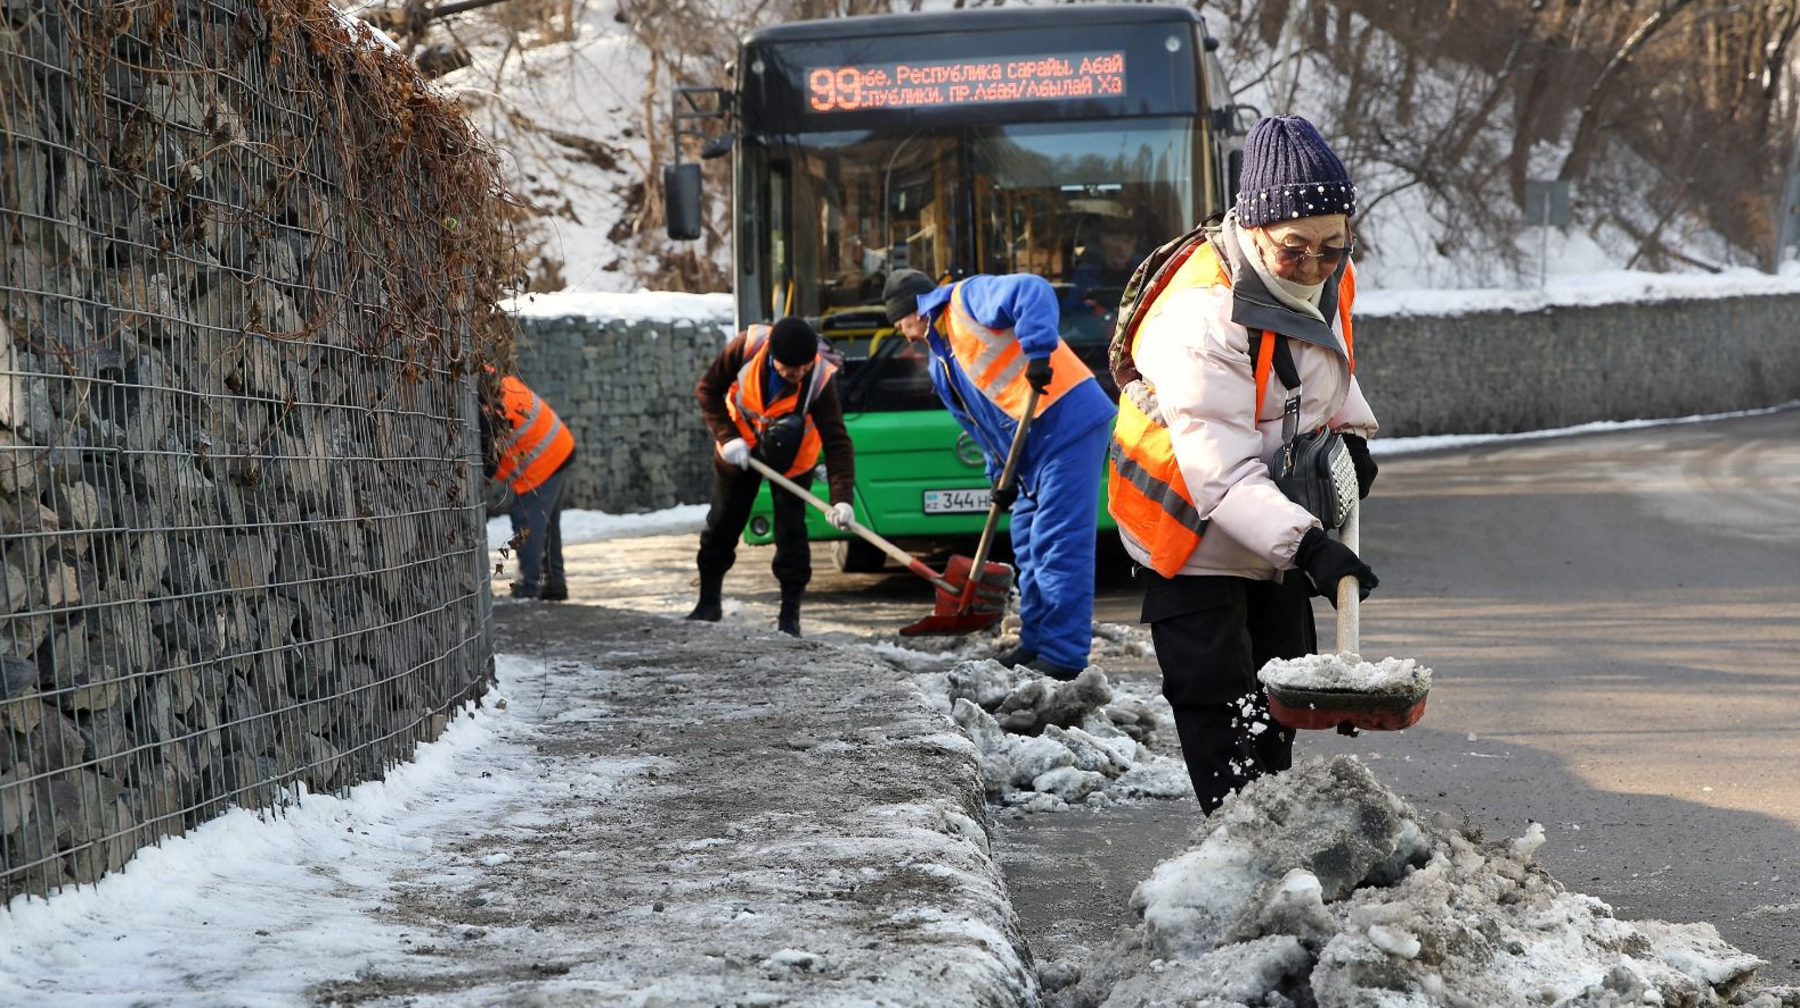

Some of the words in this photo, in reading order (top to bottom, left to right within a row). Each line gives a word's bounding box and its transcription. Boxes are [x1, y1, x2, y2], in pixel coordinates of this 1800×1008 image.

[896, 63, 1002, 85] Республика
[1079, 54, 1123, 75] Абай
[809, 67, 861, 111] 99
[1097, 74, 1122, 94] Ха
[943, 492, 974, 509] 344
